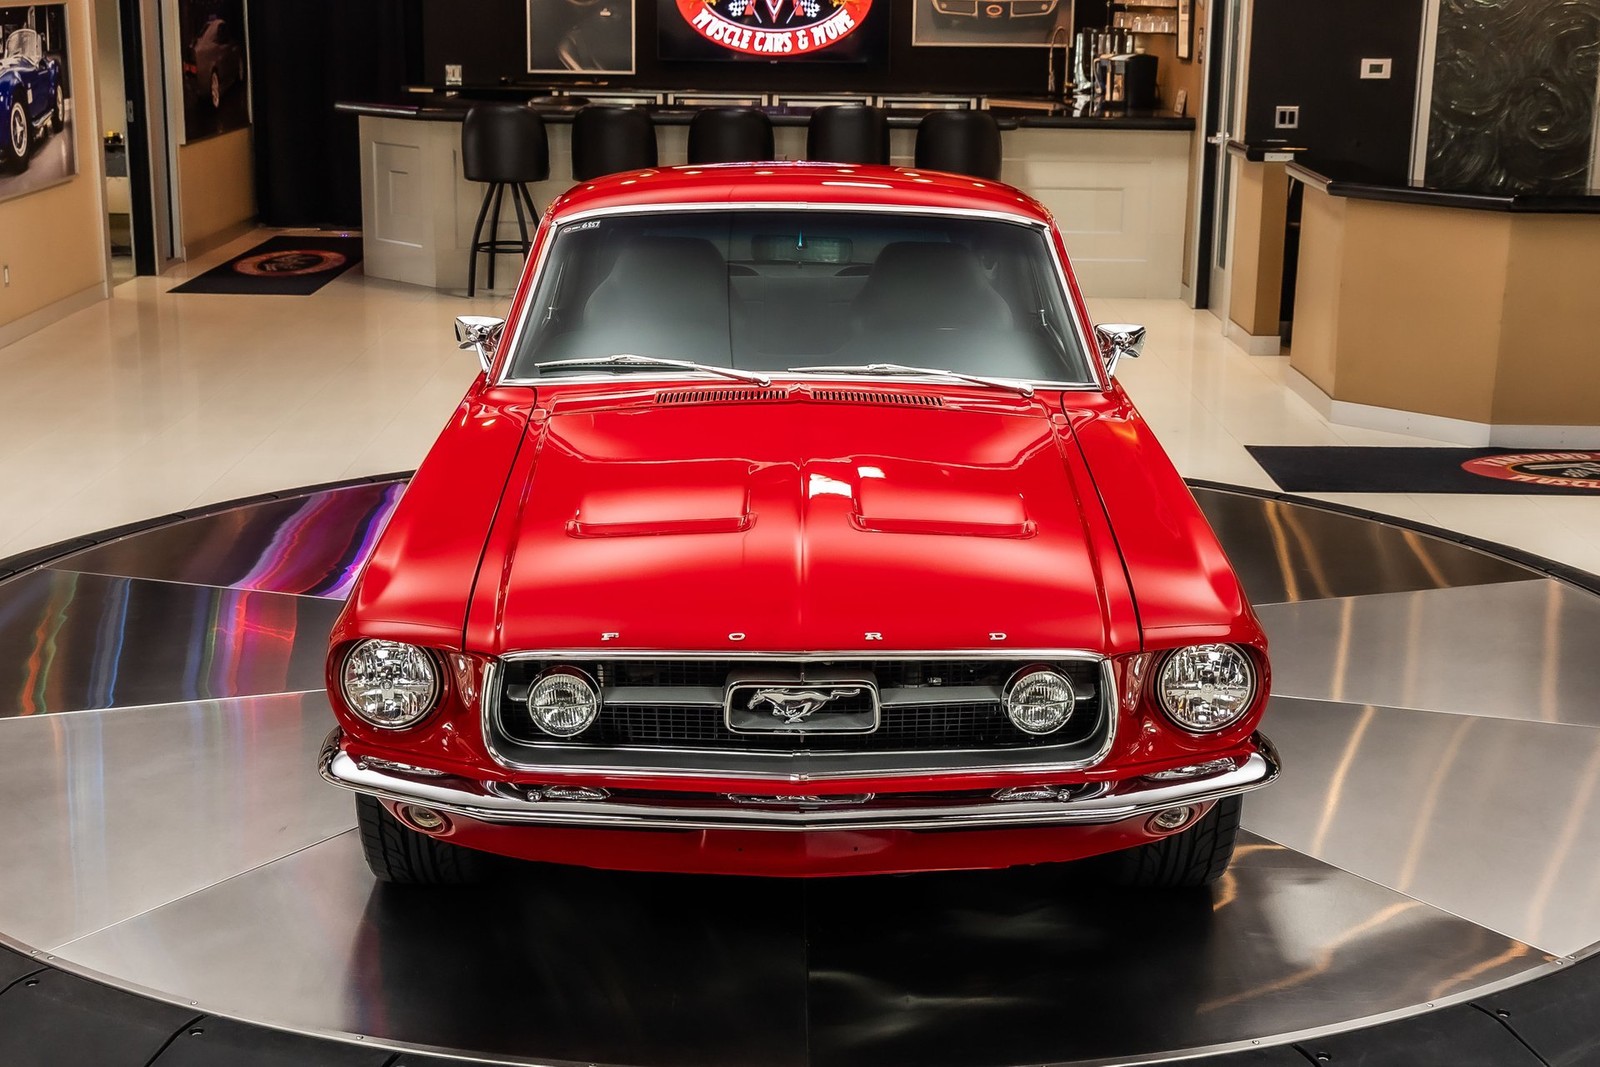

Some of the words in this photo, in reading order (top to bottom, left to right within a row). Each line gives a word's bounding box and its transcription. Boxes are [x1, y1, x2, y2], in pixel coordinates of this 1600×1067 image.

[692, 8, 752, 49] MUSCLE
[753, 32, 792, 53] CARS
[797, 31, 809, 51] &
[811, 11, 855, 46] MORE
